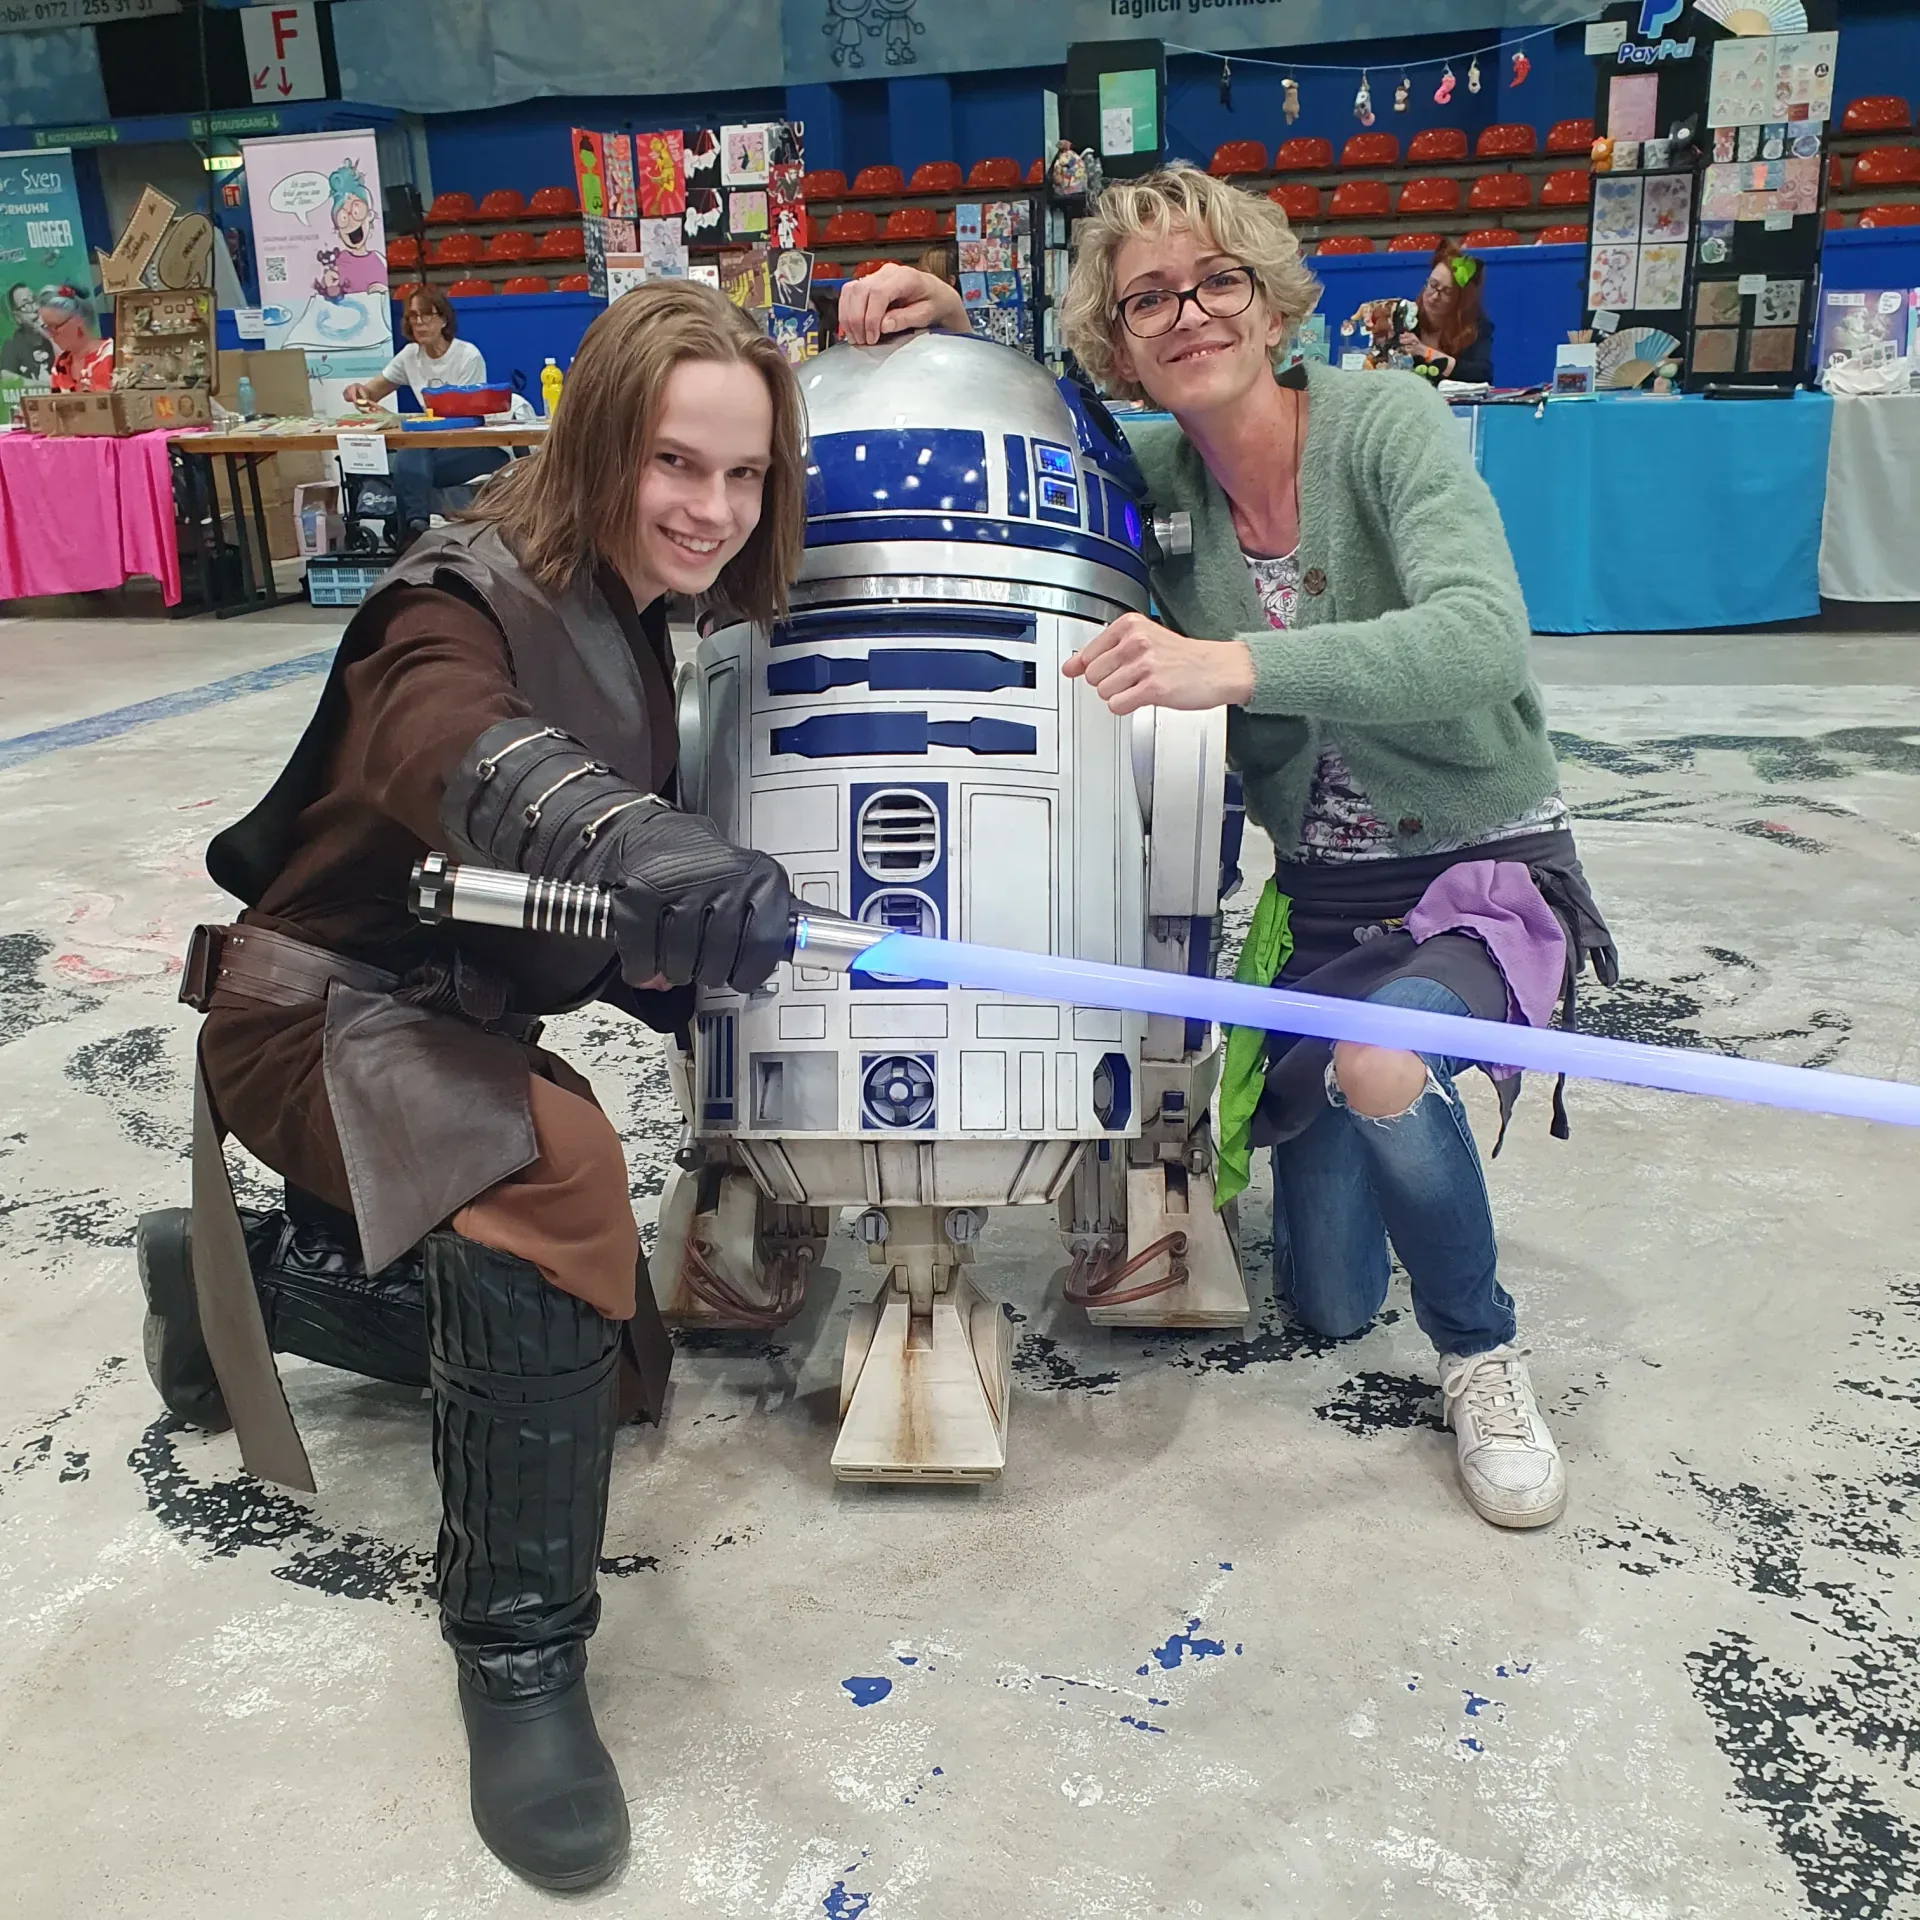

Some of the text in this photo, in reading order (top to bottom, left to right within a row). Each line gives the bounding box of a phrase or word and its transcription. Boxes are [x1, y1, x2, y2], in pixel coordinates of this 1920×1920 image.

[34, 3, 69, 19] 0172
[271, 9, 298, 60] F
[1617, 36, 1696, 65] PayPal
[21, 168, 61, 189] Sven
[26, 219, 74, 249] DIGGER
